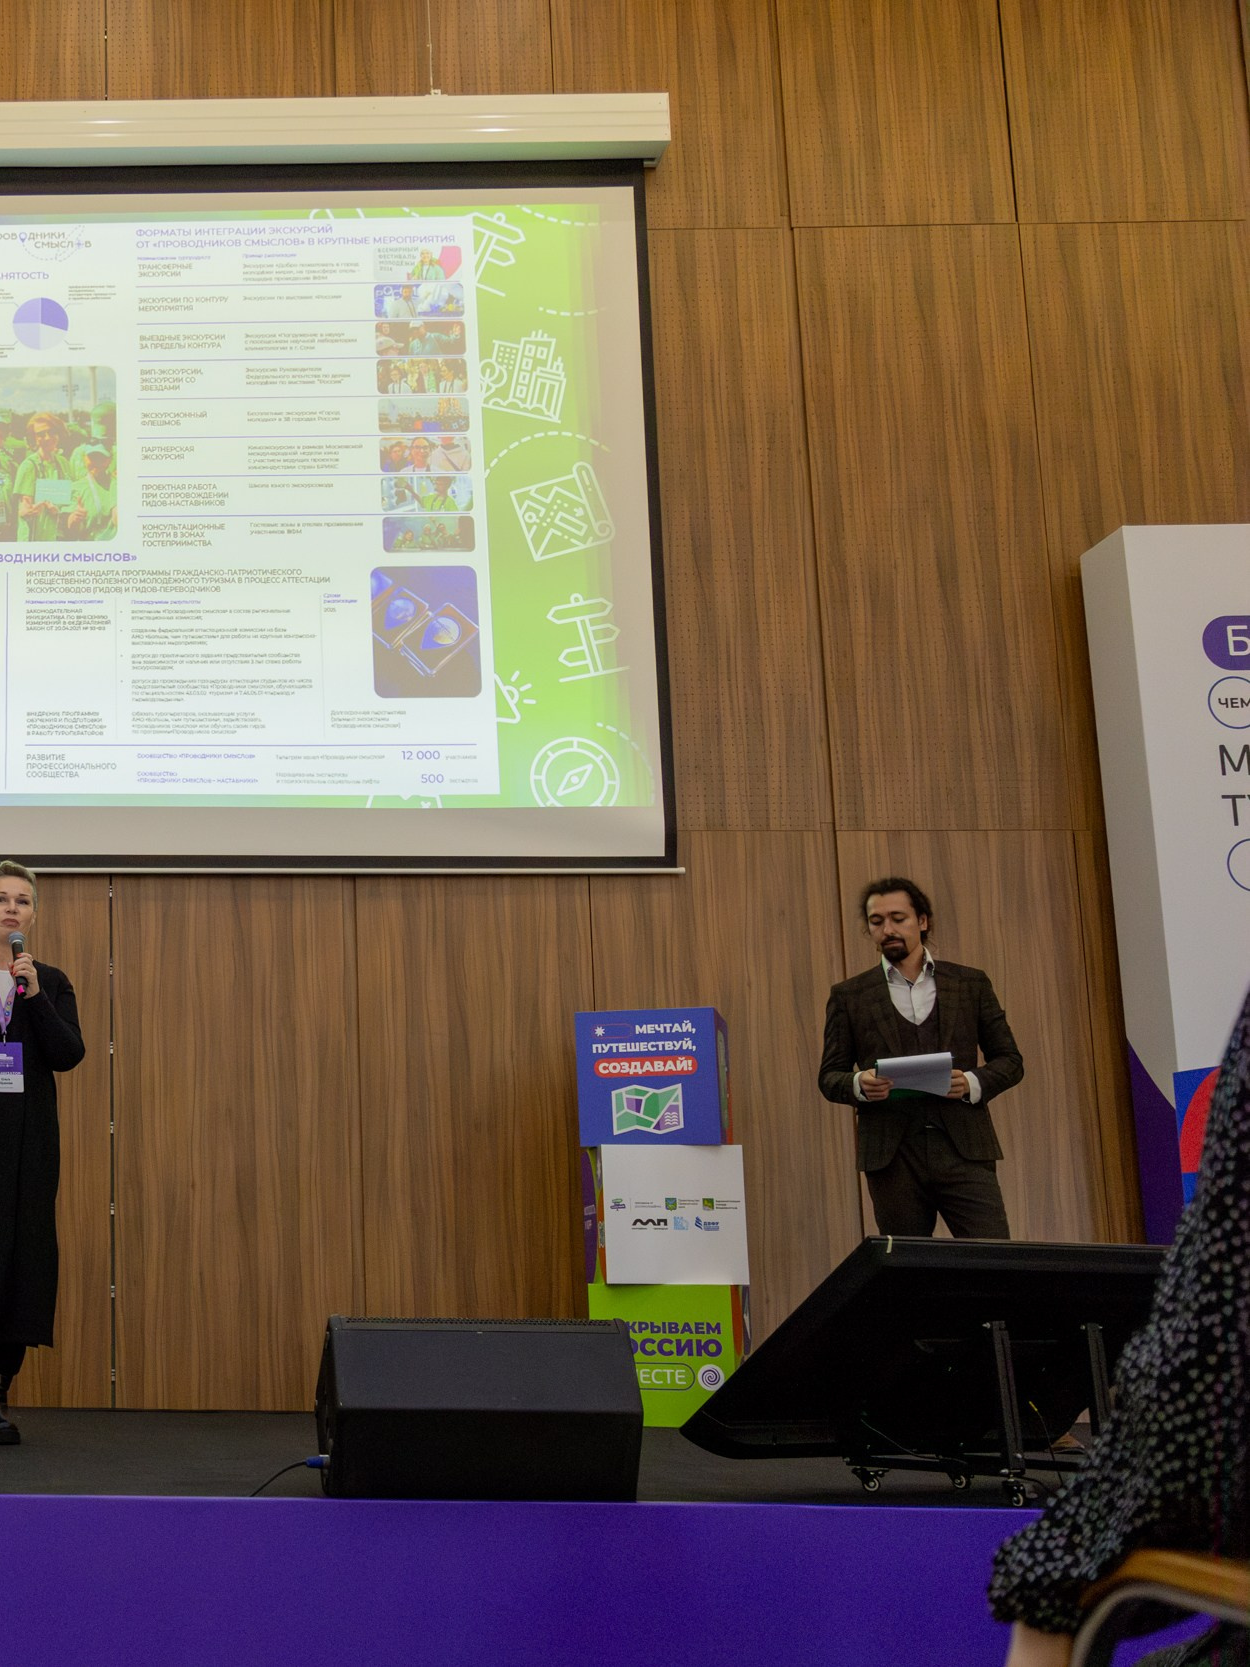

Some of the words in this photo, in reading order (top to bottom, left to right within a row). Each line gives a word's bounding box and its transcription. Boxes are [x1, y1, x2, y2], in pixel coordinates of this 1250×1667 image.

[135, 228, 191, 237] ФОРМАТЫ
[194, 227, 265, 236] ИНТЕГРАЦИИ
[269, 224, 332, 234] ЭКСКУРСИЙ
[135, 240, 148, 248] ОТ
[153, 238, 241, 249] «ПРОВОДНИКОВ
[244, 237, 304, 246] СМЫСЛОВ»
[317, 236, 369, 245] КРУПНЫЕ
[373, 234, 455, 247] МЕРОПРИЯТИЯ
[137, 262, 192, 271] ТРАНСФЕРНЫЕ
[159, 491, 228, 499] СОПРОВОЖДЕНИИ
[141, 499, 225, 507] ГИДОВ-НАСТАВНИКОВ
[142, 523, 225, 531] КОНСУЛЬТАЦИОННЫЕ
[63, 552, 137, 562] СМЫСЛОВ»
[174, 568, 302, 576] ГРАЖДАНСКО-ПАТРИОТИЧЕСКОГО
[95, 586, 123, 594] (ГИДОВ)
[402, 750, 414, 760] 12
[418, 750, 440, 760] 000
[25, 770, 79, 778] СООБЩЕСТВА
[421, 773, 444, 783] 500
[635, 1020, 696, 1034] МЕЧТАЙ,
[592, 1038, 696, 1053] ПУТЕШЕСТВУЙ,
[599, 1057, 692, 1074] СОЗДАВАЙ!
[626, 1322, 721, 1335] КРЫВАЕМ
[637, 1369, 686, 1384] ЕСТЕ
